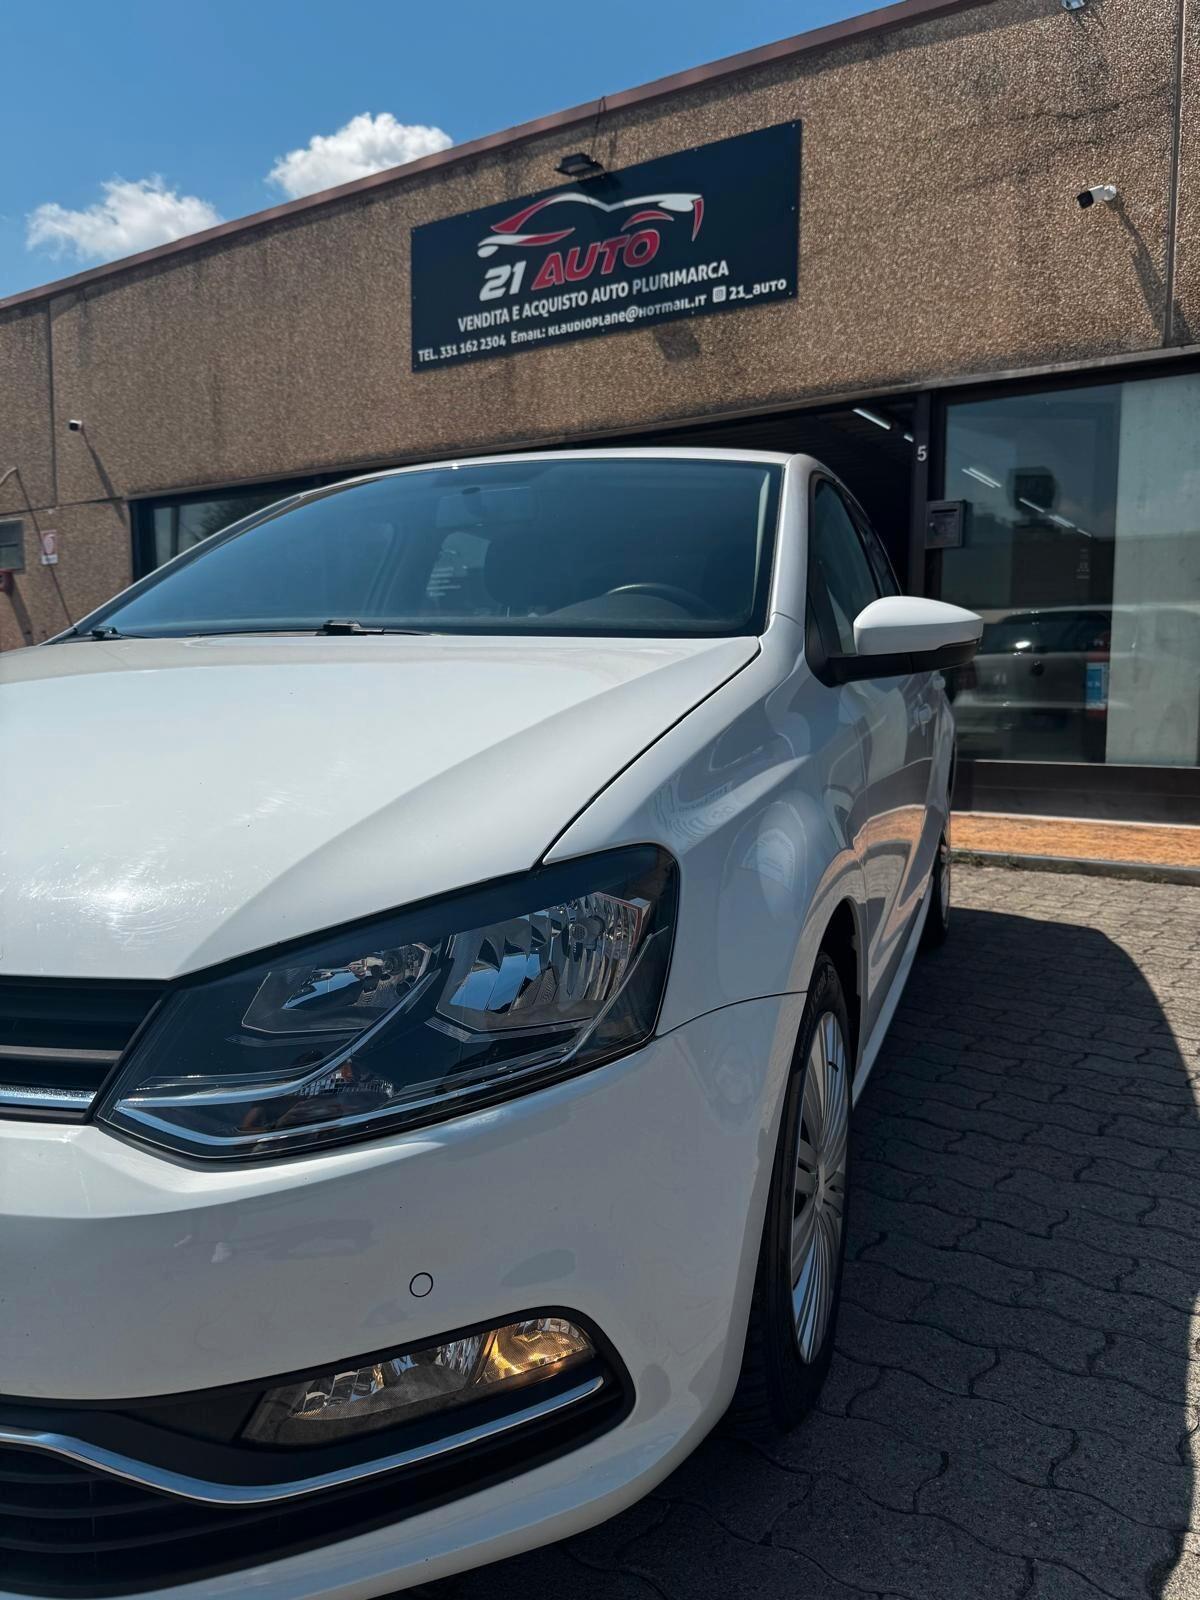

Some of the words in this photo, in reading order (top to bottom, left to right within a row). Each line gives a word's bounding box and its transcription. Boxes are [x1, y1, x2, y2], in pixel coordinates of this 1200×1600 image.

[479, 260, 527, 301] 21
[530, 228, 661, 291] AUTO
[457, 307, 511, 333] VENDITA
[511, 305, 521, 321] E
[521, 290, 589, 319] ACQUISTO
[590, 281, 629, 304] AUTO
[632, 260, 730, 295] PLURIMARCA
[418, 349, 438, 363] TEL.
[440, 344, 458, 359] 331
[460, 340, 479, 355] 162
[480, 334, 507, 352] 2304
[917, 445, 927, 461] 5
